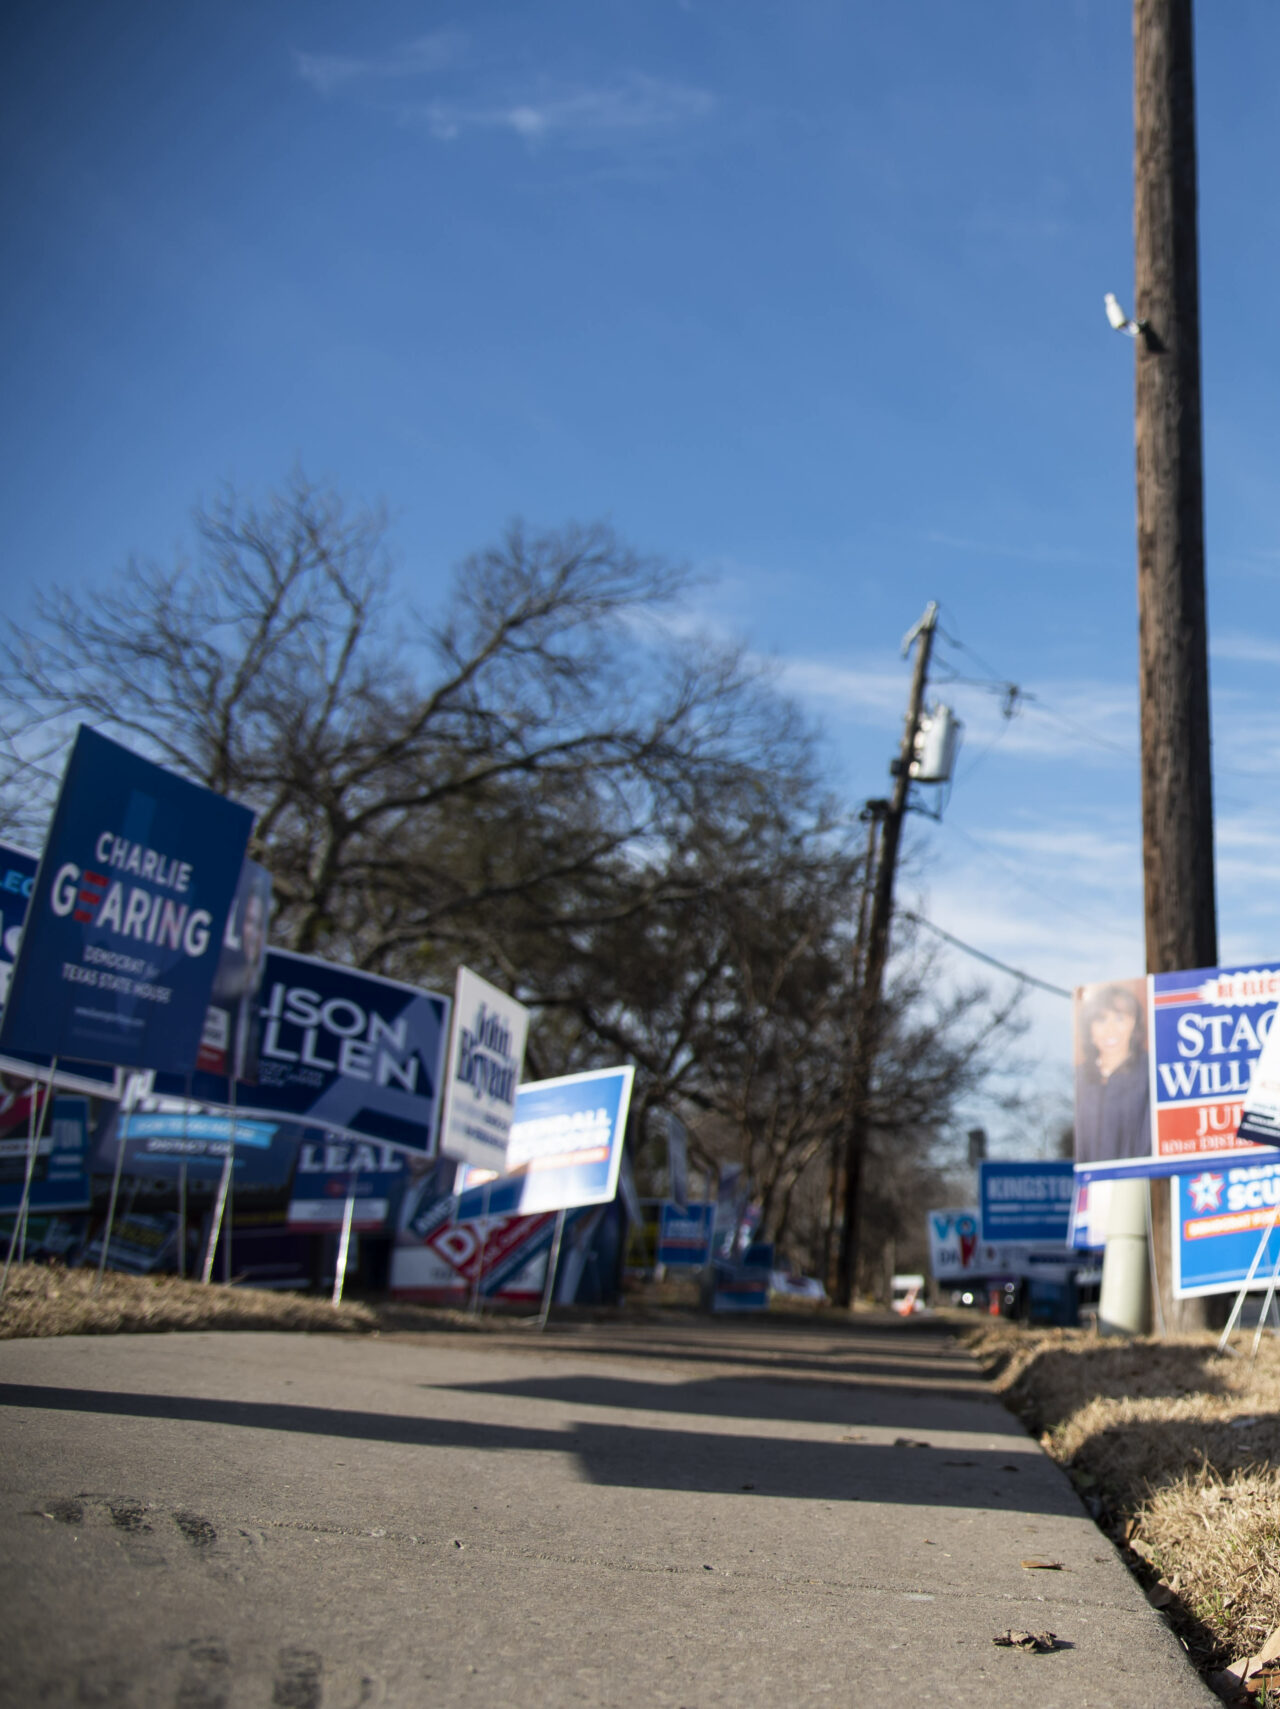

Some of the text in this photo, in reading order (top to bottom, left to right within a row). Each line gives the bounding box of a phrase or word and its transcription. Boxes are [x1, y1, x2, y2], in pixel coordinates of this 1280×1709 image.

[95, 830, 193, 893] CHARLIE
[51, 861, 212, 958] GEARING
[62, 962, 172, 1003] TEXAS STATE HOUSE
[83, 943, 146, 974] DEMOCRAT
[259, 983, 408, 1048] ISON
[299, 1143, 402, 1172] LEAL
